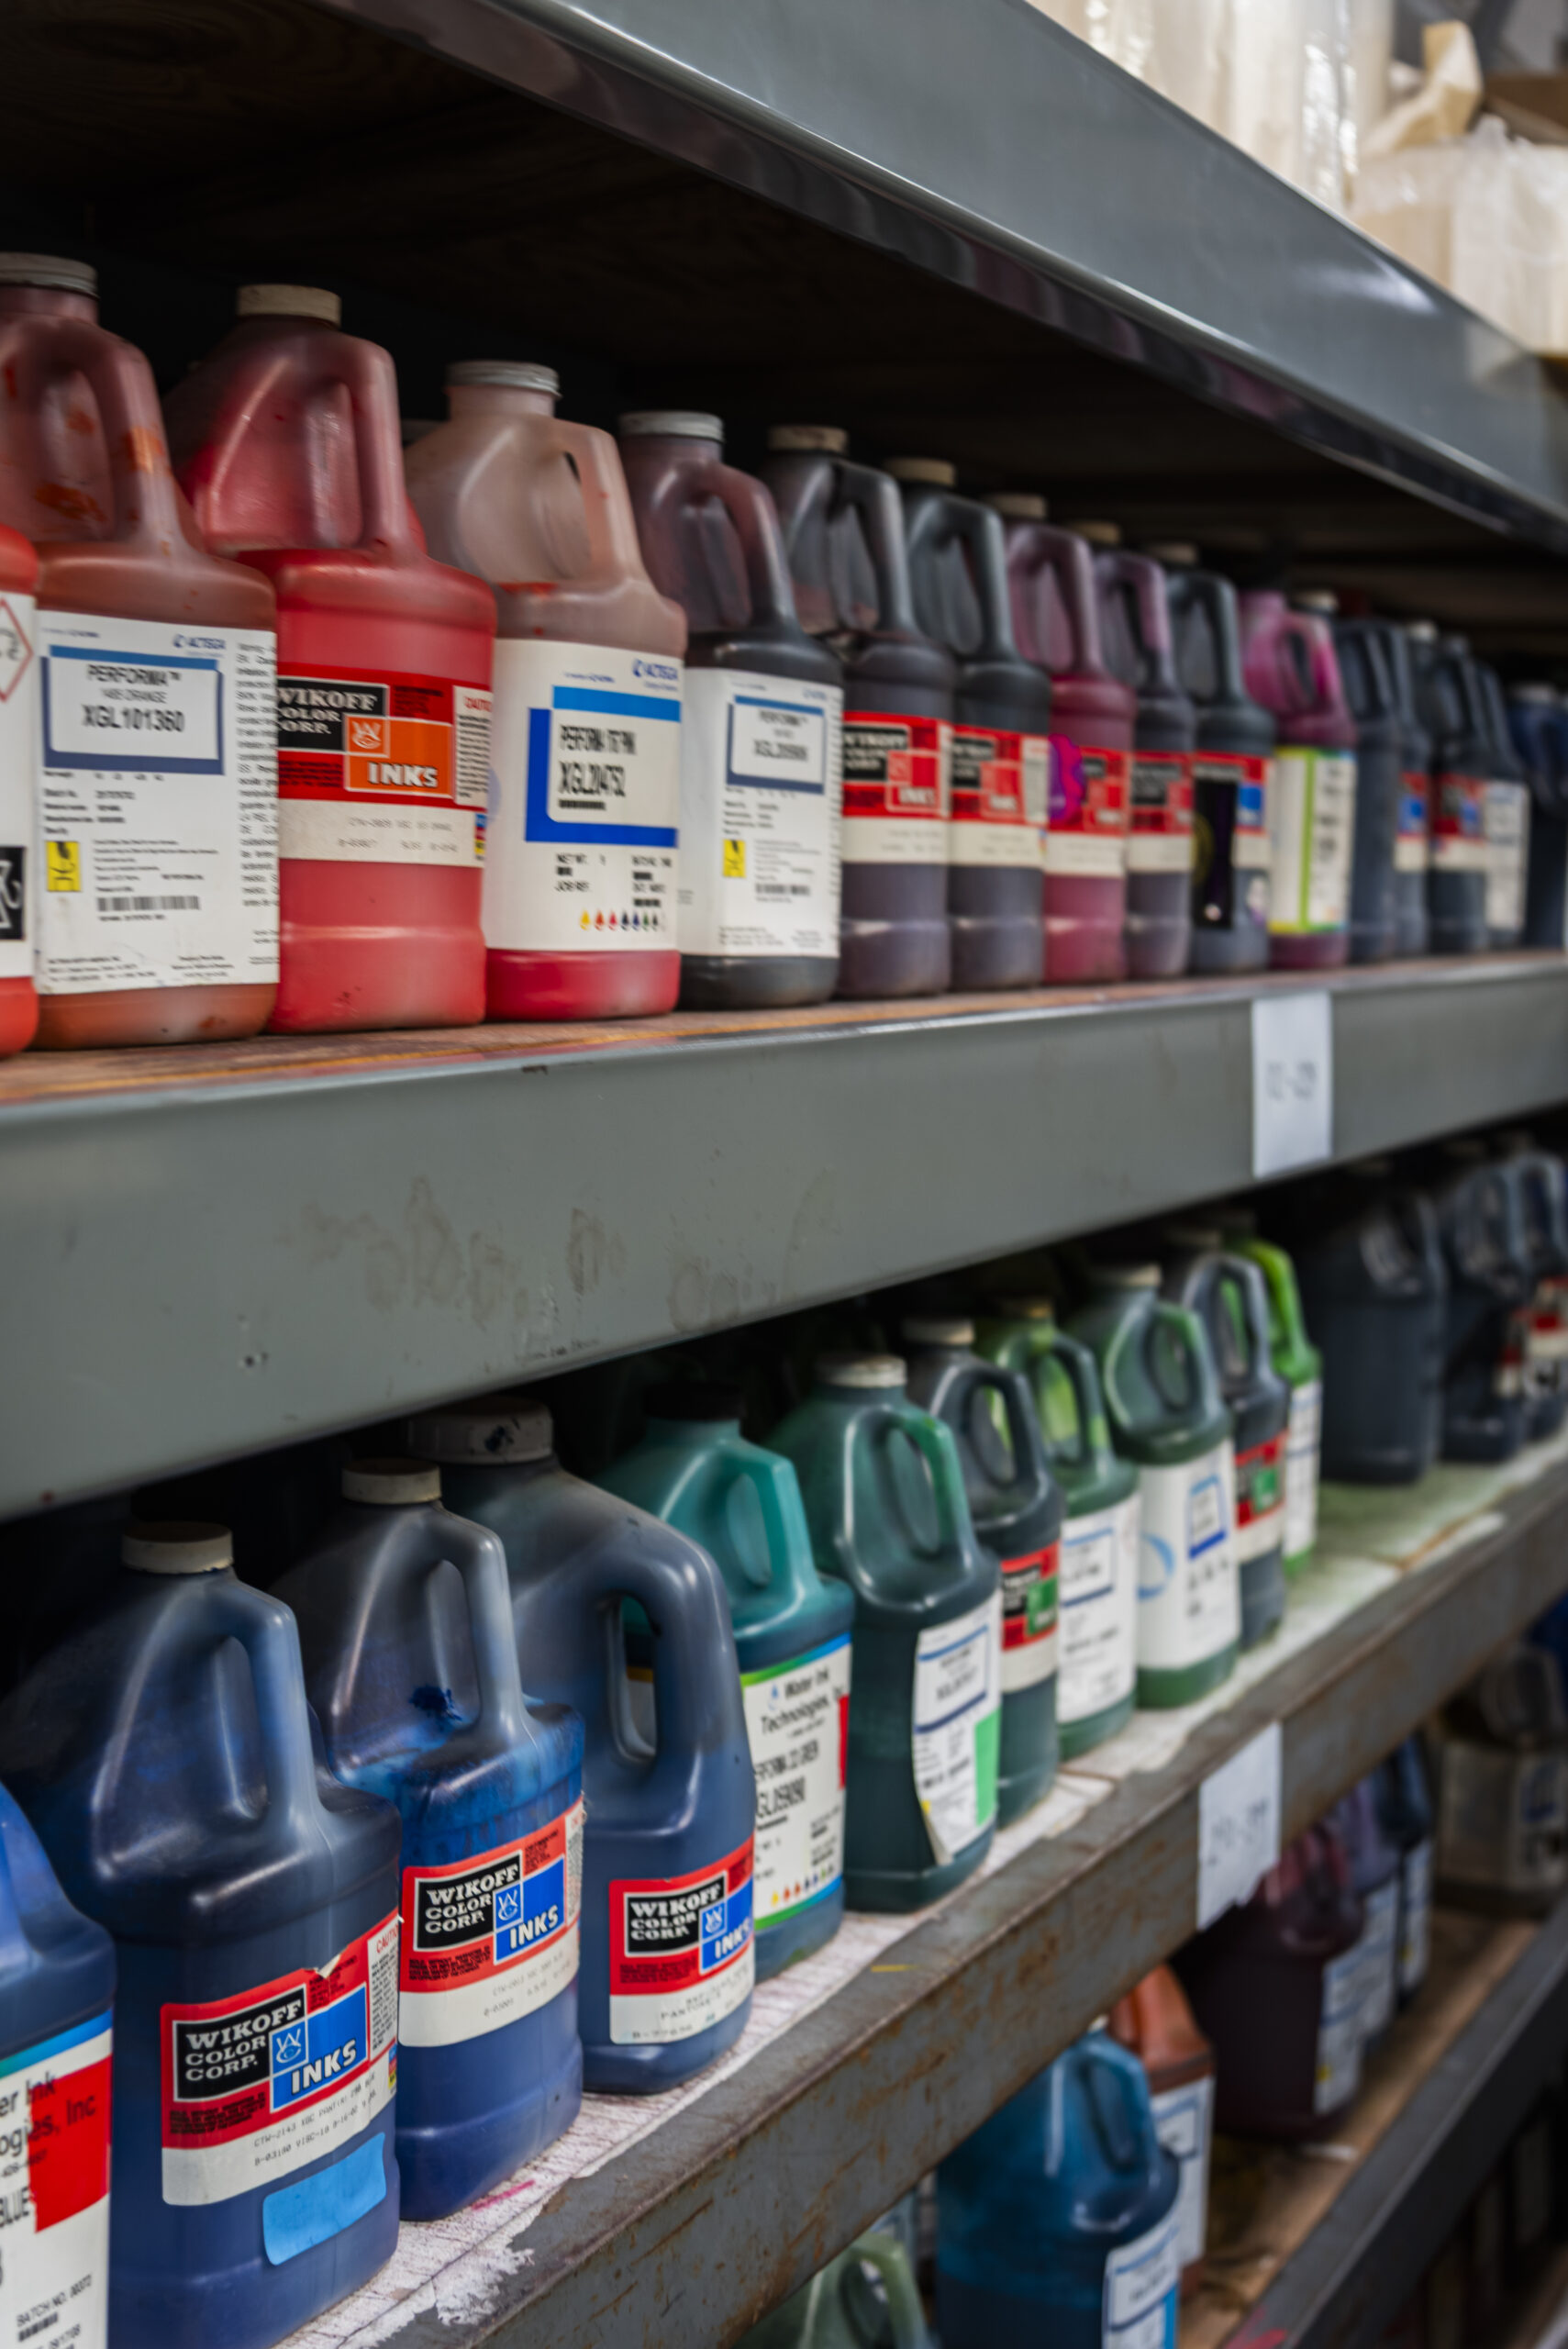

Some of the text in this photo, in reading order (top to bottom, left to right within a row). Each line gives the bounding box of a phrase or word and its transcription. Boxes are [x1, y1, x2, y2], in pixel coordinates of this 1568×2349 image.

[277, 707, 341, 723] OLOR
[367, 761, 439, 789] INKS
[426, 1863, 519, 1906] WIKOFF
[630, 1883, 721, 1919] WIKOFF
[425, 1893, 493, 1920] COLOR
[630, 1910, 697, 1930] COLOR
[509, 1904, 559, 1950] INKS
[185, 1998, 302, 2051] WIKOFF
[185, 2034, 266, 2066] COLOR
[185, 2054, 259, 2082] CORP.
[291, 2037, 358, 2097] INKS
[26, 2070, 56, 2106] Ink
[66, 2094, 96, 2127] Inc
